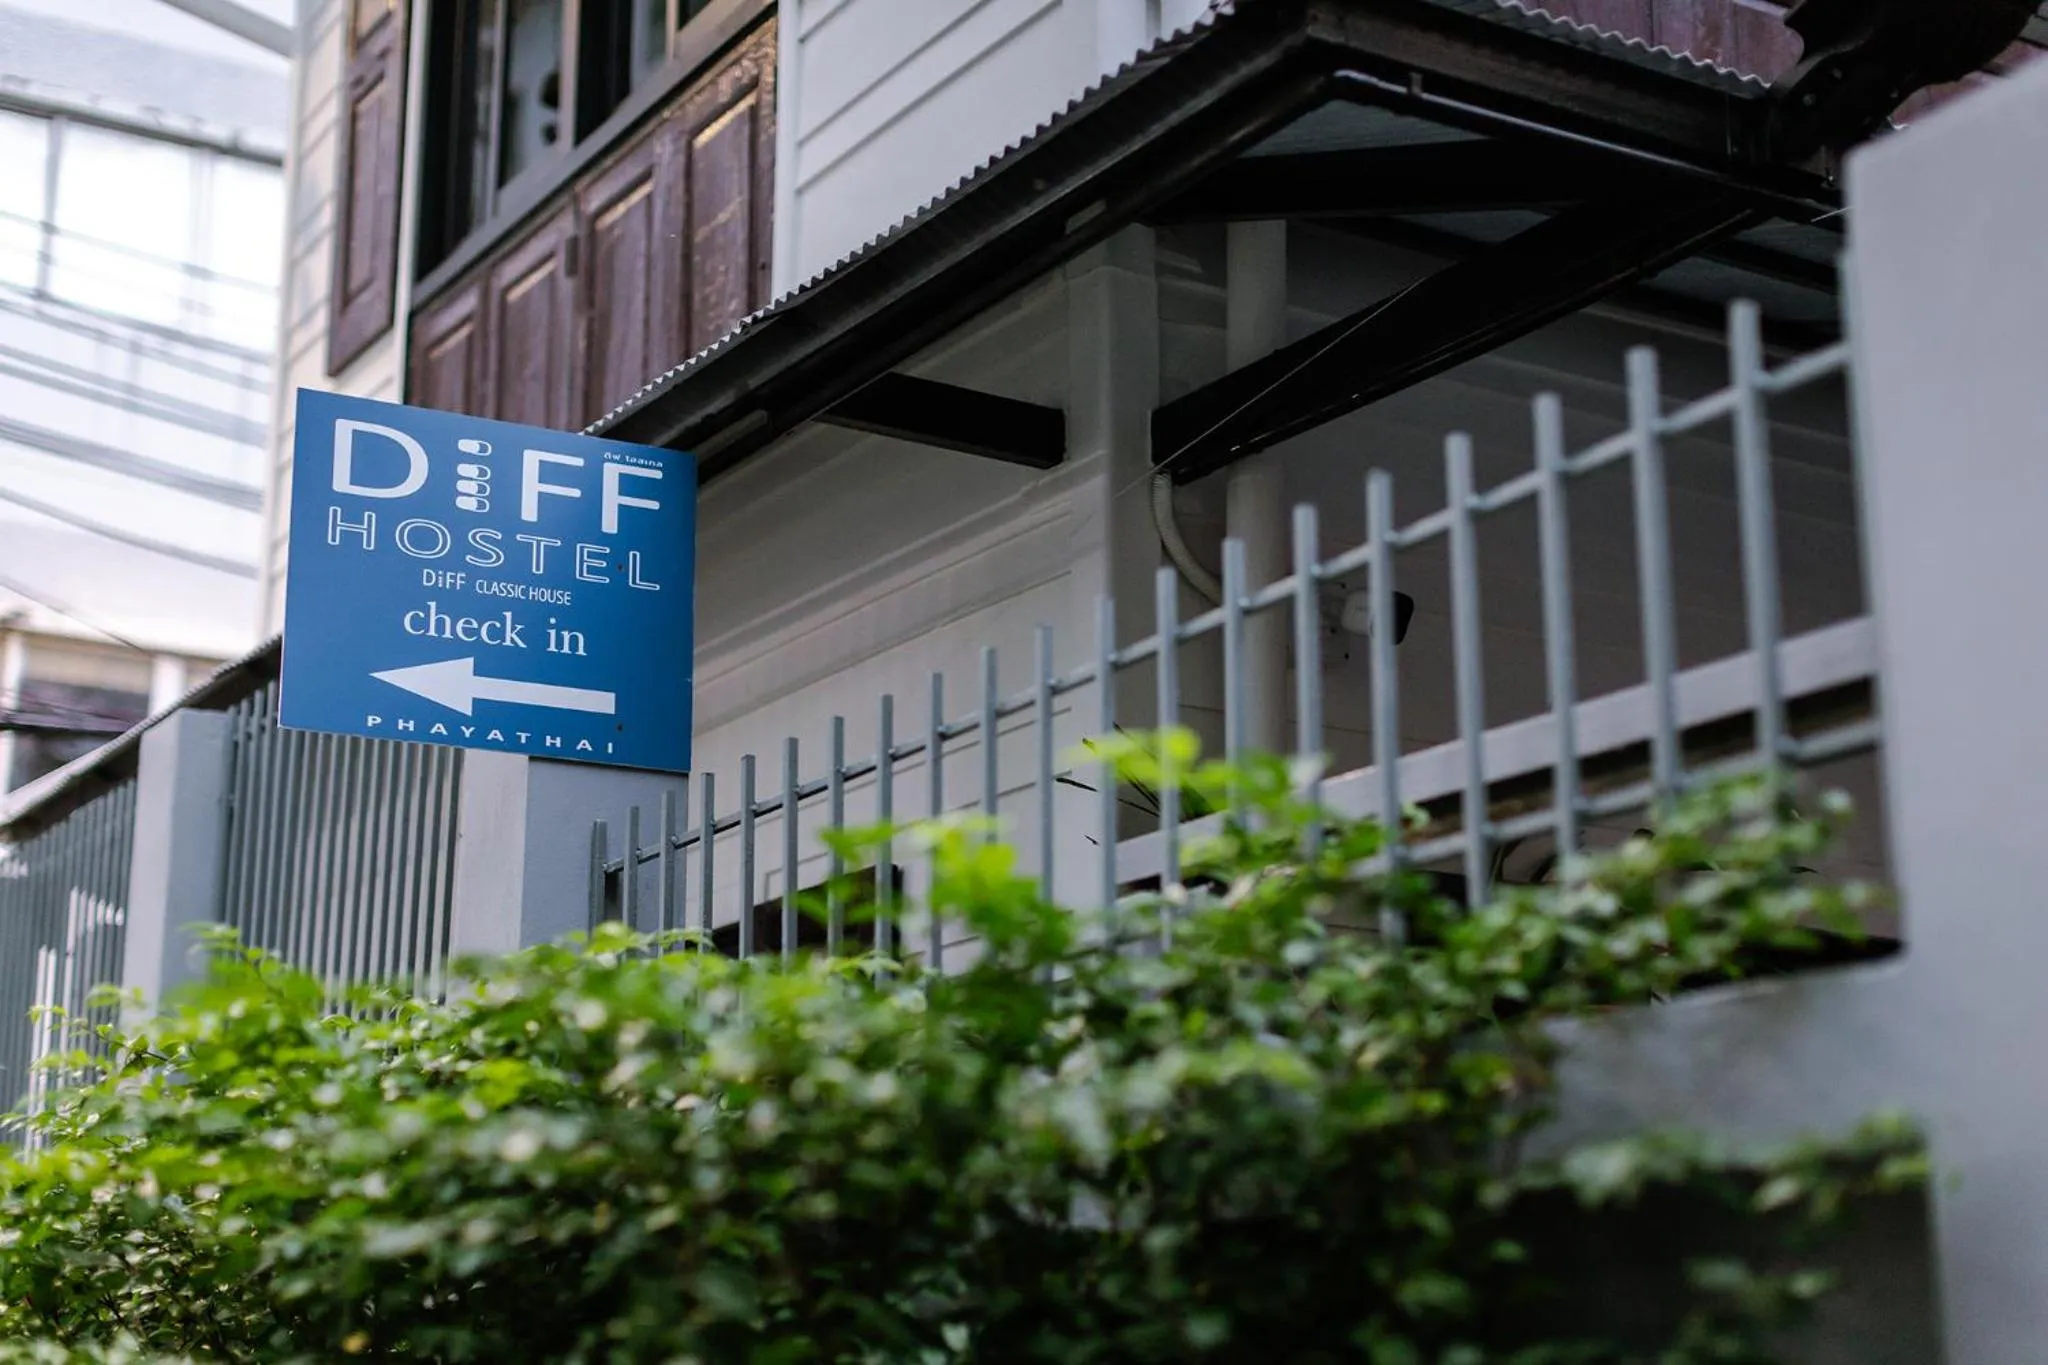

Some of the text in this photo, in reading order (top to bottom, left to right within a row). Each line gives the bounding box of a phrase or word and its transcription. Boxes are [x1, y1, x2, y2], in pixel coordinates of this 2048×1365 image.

[327, 506, 661, 591] HOSTEL
[475, 579, 526, 600] CLASSIC
[529, 586, 572, 606] HOUSE
[403, 602, 587, 656] check in
[366, 715, 614, 754] PHAYATHAI
